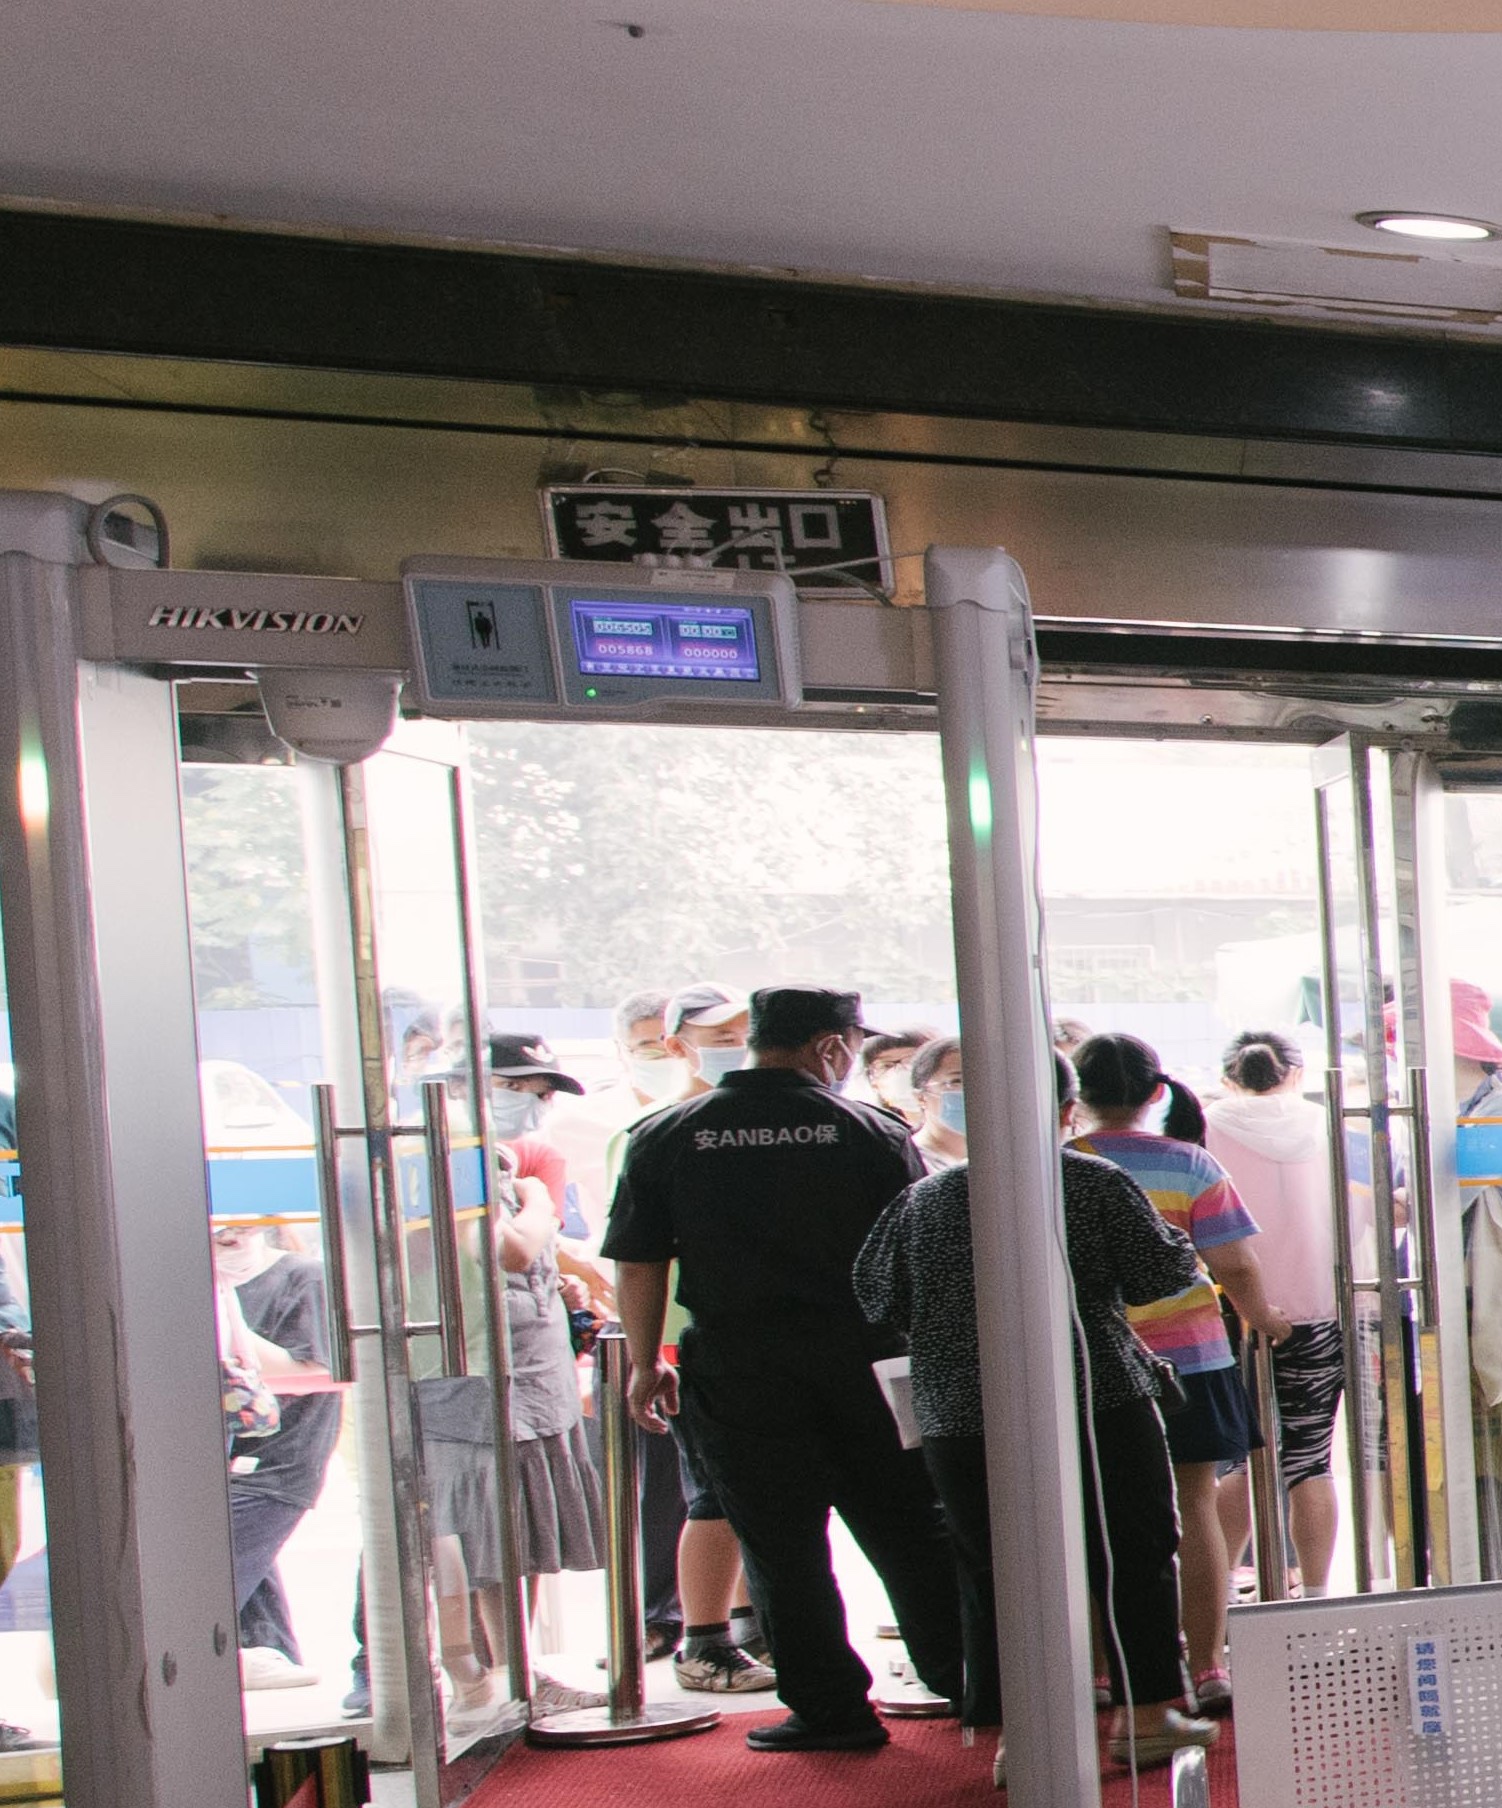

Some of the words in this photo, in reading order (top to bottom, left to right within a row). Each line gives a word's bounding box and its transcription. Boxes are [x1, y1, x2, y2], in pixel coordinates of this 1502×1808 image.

[574, 500, 842, 549] 安全出口
[148, 605, 364, 635] HIKVISION
[684, 647, 739, 660] 000000
[694, 1124, 840, 1151] 安ANBAO保
